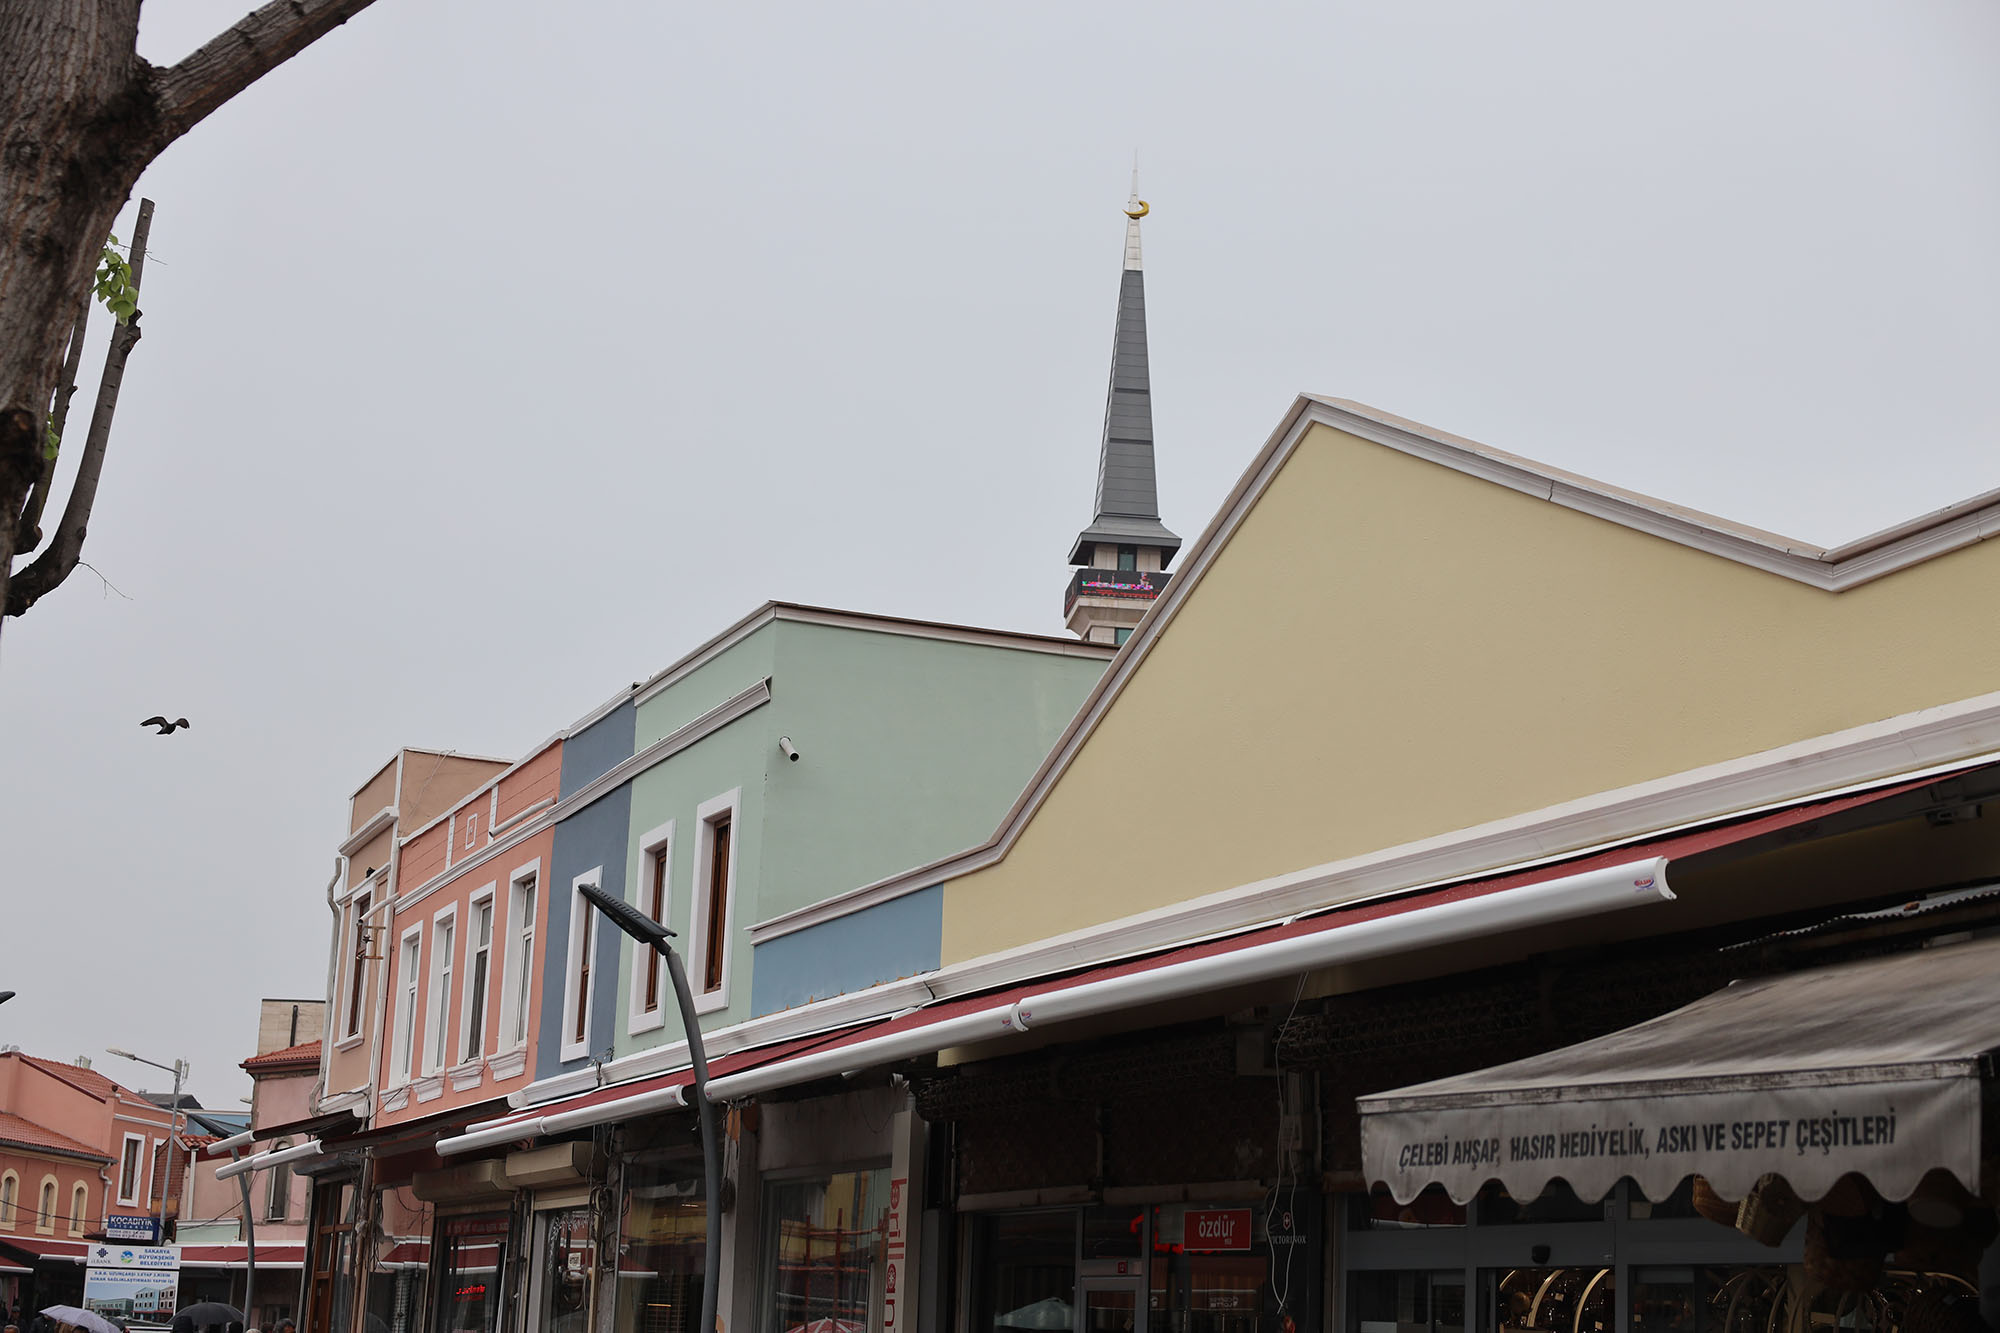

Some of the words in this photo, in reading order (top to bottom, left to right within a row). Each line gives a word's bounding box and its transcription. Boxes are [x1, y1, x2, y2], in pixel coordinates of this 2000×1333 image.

[1398, 1135, 1449, 1172] ÇELEBİ
[1451, 1137, 1501, 1170] AHŞAP,
[1509, 1134, 1556, 1162] HASIR
[1559, 1122, 1650, 1160] HEDİYELİK,
[1656, 1124, 1697, 1154] ASKI
[1702, 1123, 1726, 1152] VE
[1731, 1119, 1791, 1151] SEPET
[1795, 1106, 1896, 1156] ÇEŞİTLERİ
[884, 1178, 908, 1333] brillan
[1198, 1214, 1236, 1238] özdür
